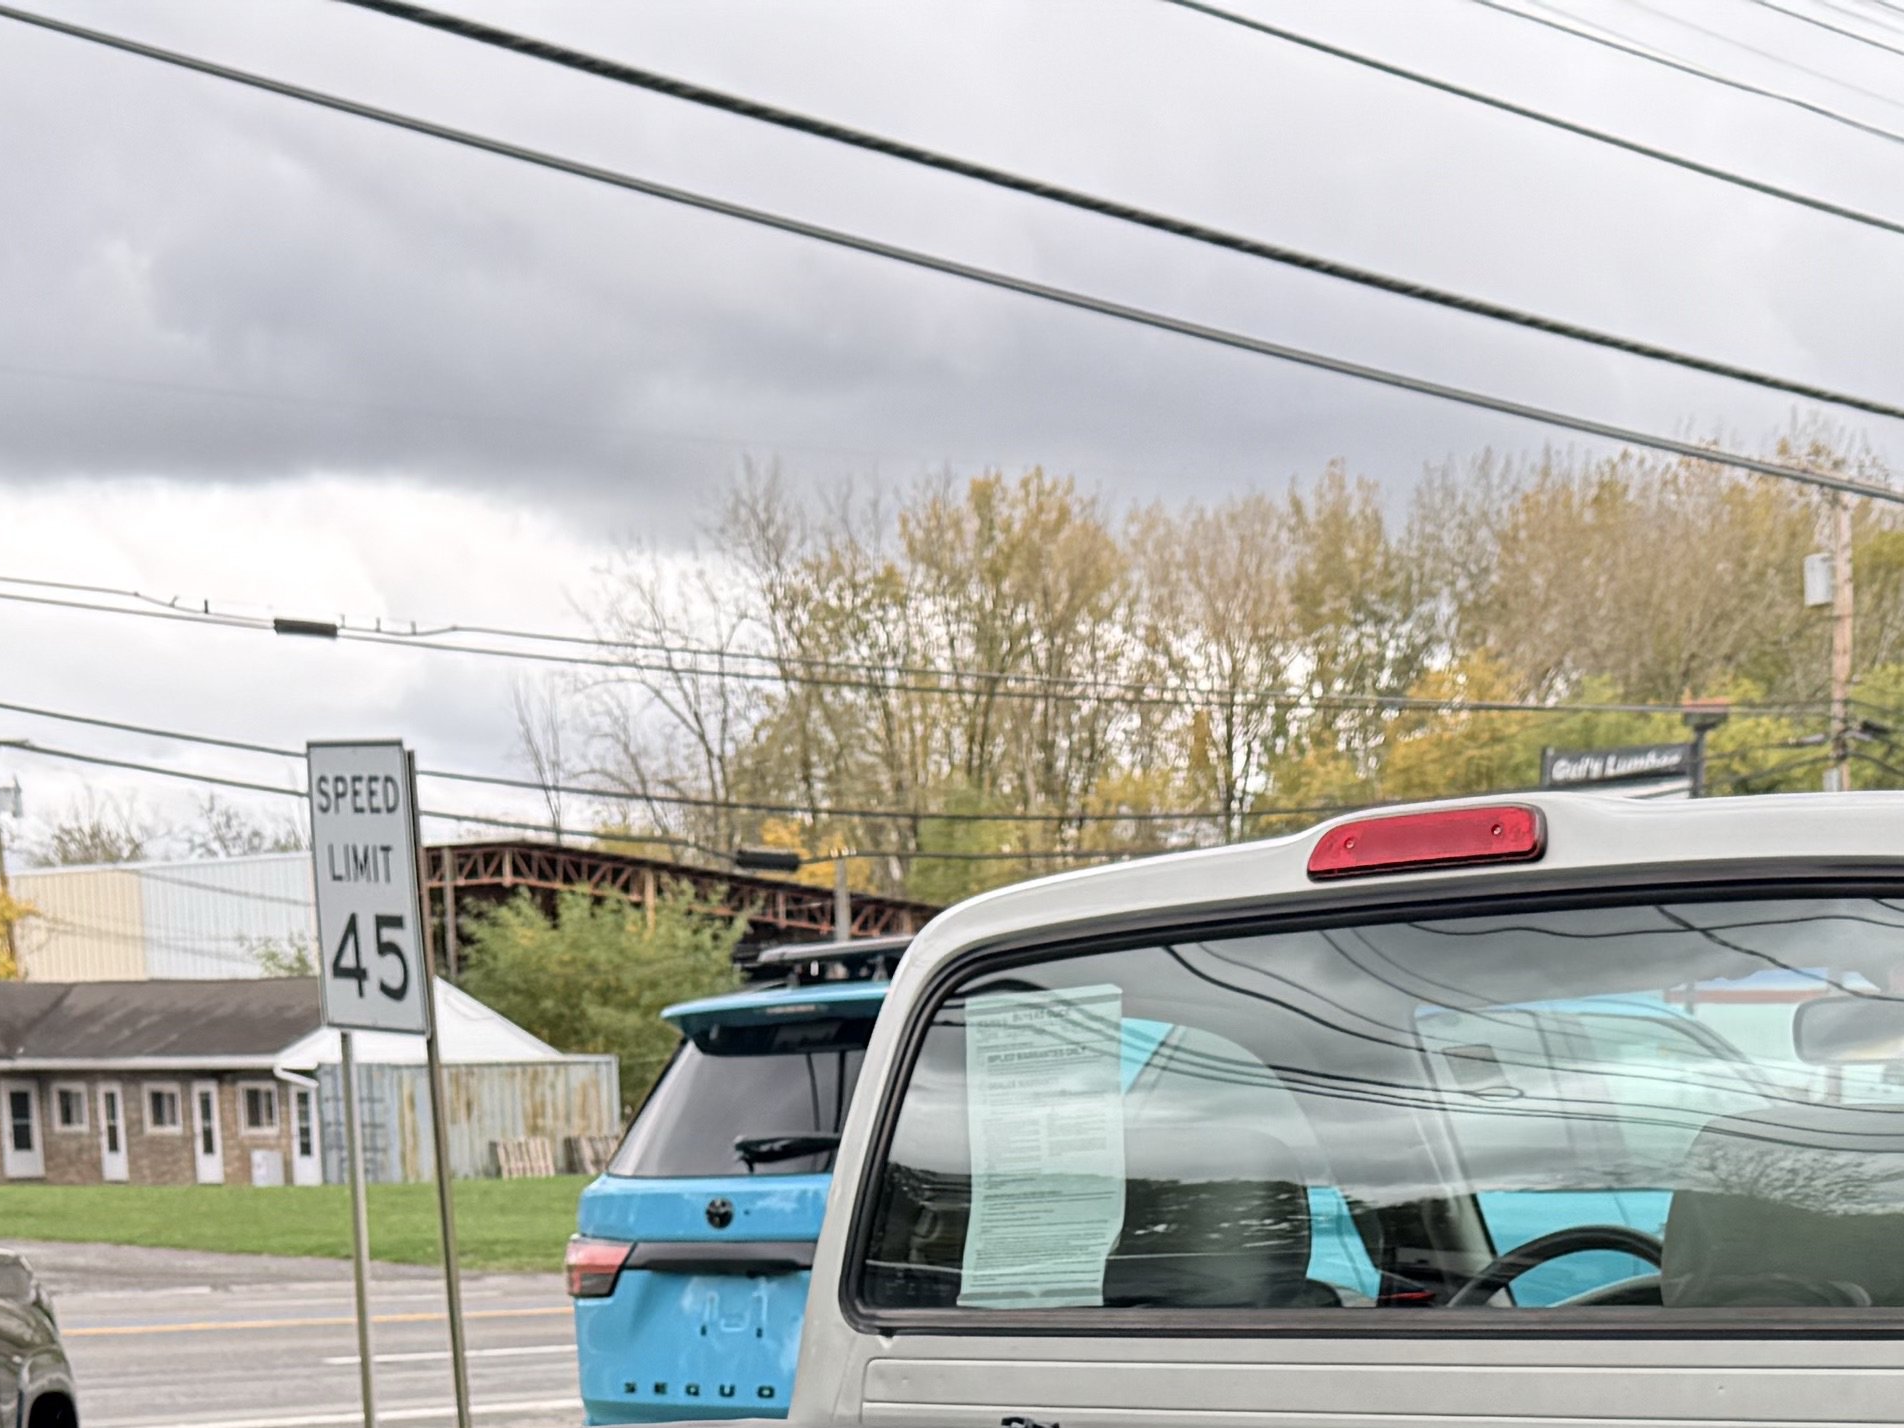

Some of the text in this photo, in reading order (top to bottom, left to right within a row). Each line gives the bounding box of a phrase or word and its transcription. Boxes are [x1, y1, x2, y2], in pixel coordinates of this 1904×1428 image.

[316, 775, 400, 814] SPEED
[328, 844, 393, 884] LIMIT
[332, 912, 410, 1002] 45
